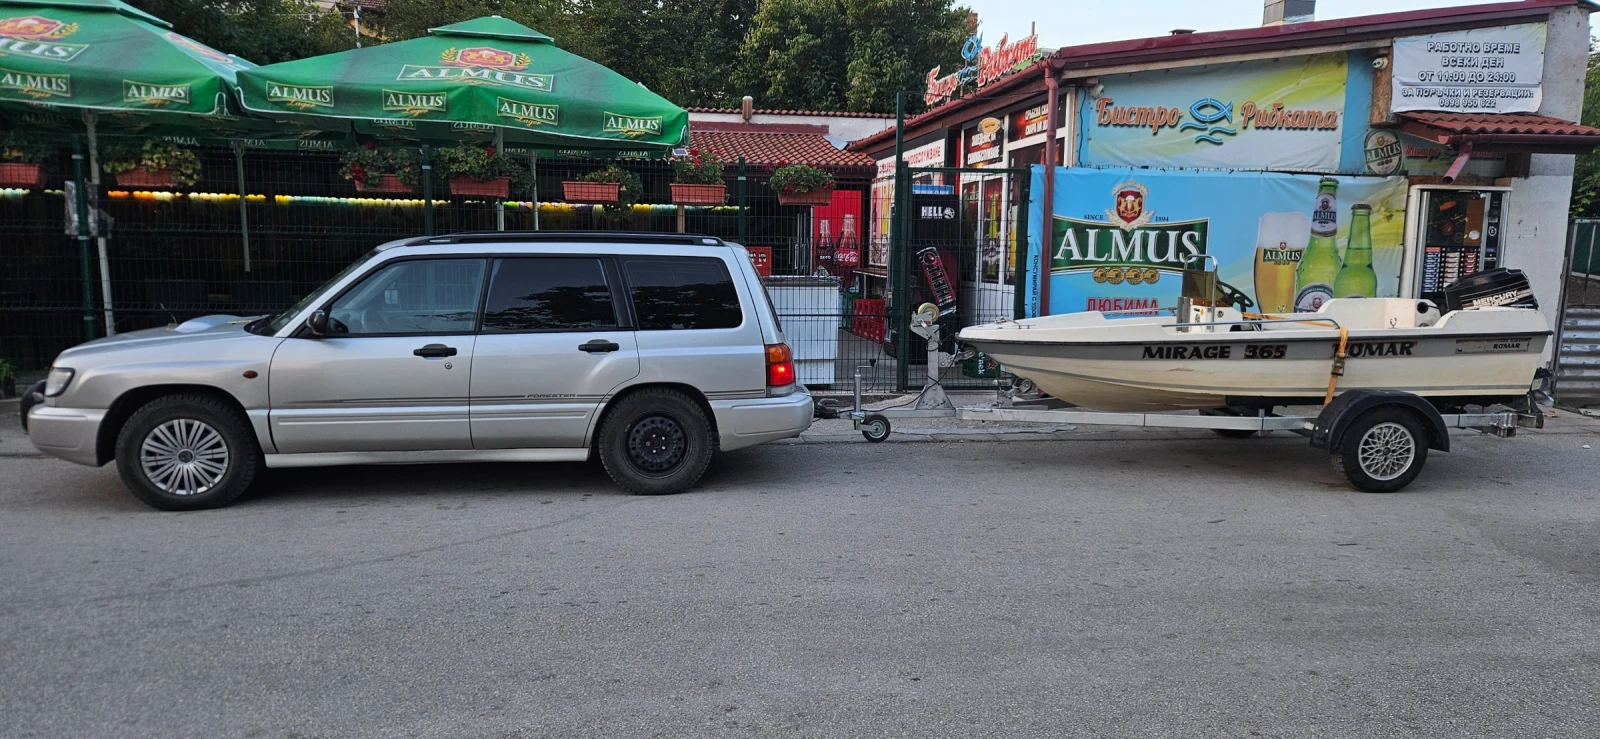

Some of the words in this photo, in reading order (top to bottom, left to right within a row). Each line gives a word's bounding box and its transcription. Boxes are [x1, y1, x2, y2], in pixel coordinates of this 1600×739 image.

[1427, 42, 1481, 53] РАБОТНО
[1483, 43, 1521, 54] ВРЕМЕ
[1441, 57, 1479, 67] ВСЕКИ
[1480, 57, 1505, 69] ДЕН
[1, 72, 67, 92] ALMUS
[408, 68, 546, 88] ALMUS
[1418, 71, 1433, 82] ОТ
[1437, 71, 1466, 82] 11:00
[1468, 72, 1485, 83] ДО
[1487, 71, 1516, 83] 24:00
[127, 84, 186, 99] ALMUS
[269, 85, 331, 103] ALMUS
[1402, 88, 1415, 98] ЗА
[1416, 88, 1462, 98] ПОРЪЧКИ
[1463, 88, 1470, 98] И
[1472, 88, 1534, 99] РЕЗЕРВАЦИИ:
[386, 93, 444, 107] ALMUS
[1438, 98, 1461, 107] 0898
[1462, 98, 1479, 107] 950
[1480, 98, 1496, 107] 622
[403, 105, 429, 117] Lager
[500, 102, 556, 121] ALMUS
[1095, 98, 1183, 133] Бистро
[1240, 100, 1337, 128] Рибката
[515, 115, 542, 127] Lager
[606, 116, 659, 130] ALMUS
[1366, 141, 1401, 161] ALMUS
[921, 206, 943, 217] HELL
[1053, 227, 1200, 263] ALMUS
[1264, 250, 1301, 261] ALMUS
[1472, 290, 1518, 307] MERCURY
[1085, 297, 1159, 316] ЛЮБИМА
[1142, 345, 1231, 359] MIRAGE
[1244, 344, 1287, 359] 365
